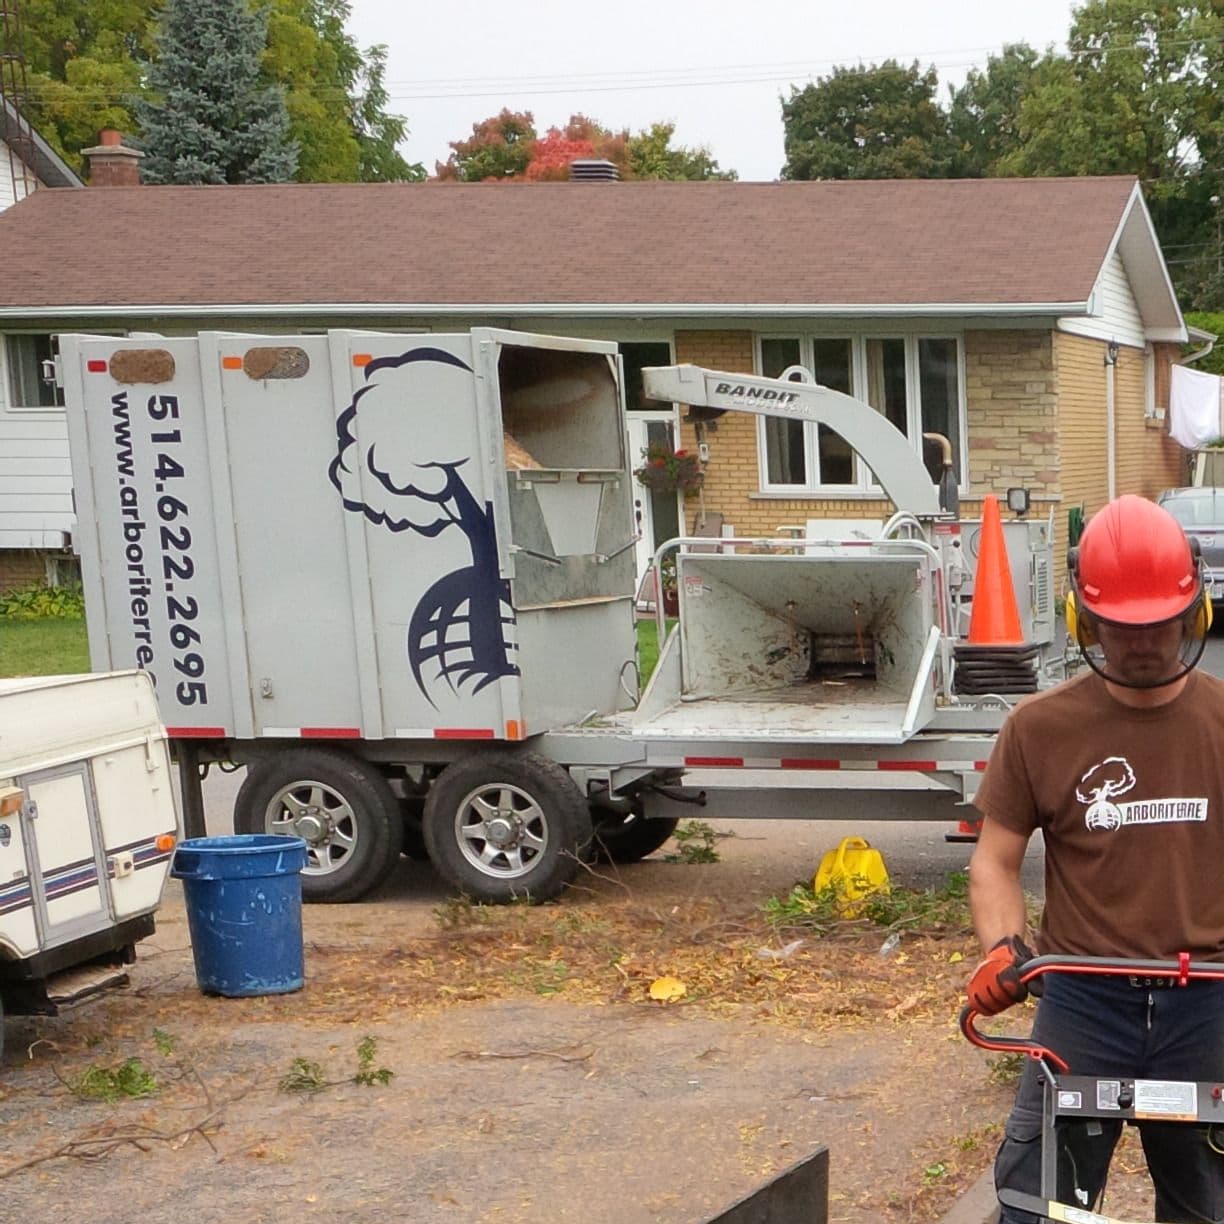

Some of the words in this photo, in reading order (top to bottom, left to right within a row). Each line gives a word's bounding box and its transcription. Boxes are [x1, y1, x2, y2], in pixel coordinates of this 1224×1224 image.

[715, 383, 800, 403] BANDIT
[111, 391, 158, 688] www.arboriterre.
[147, 394, 208, 706] 514.622.2695
[1126, 802, 1203, 823] ARBORITERRE
